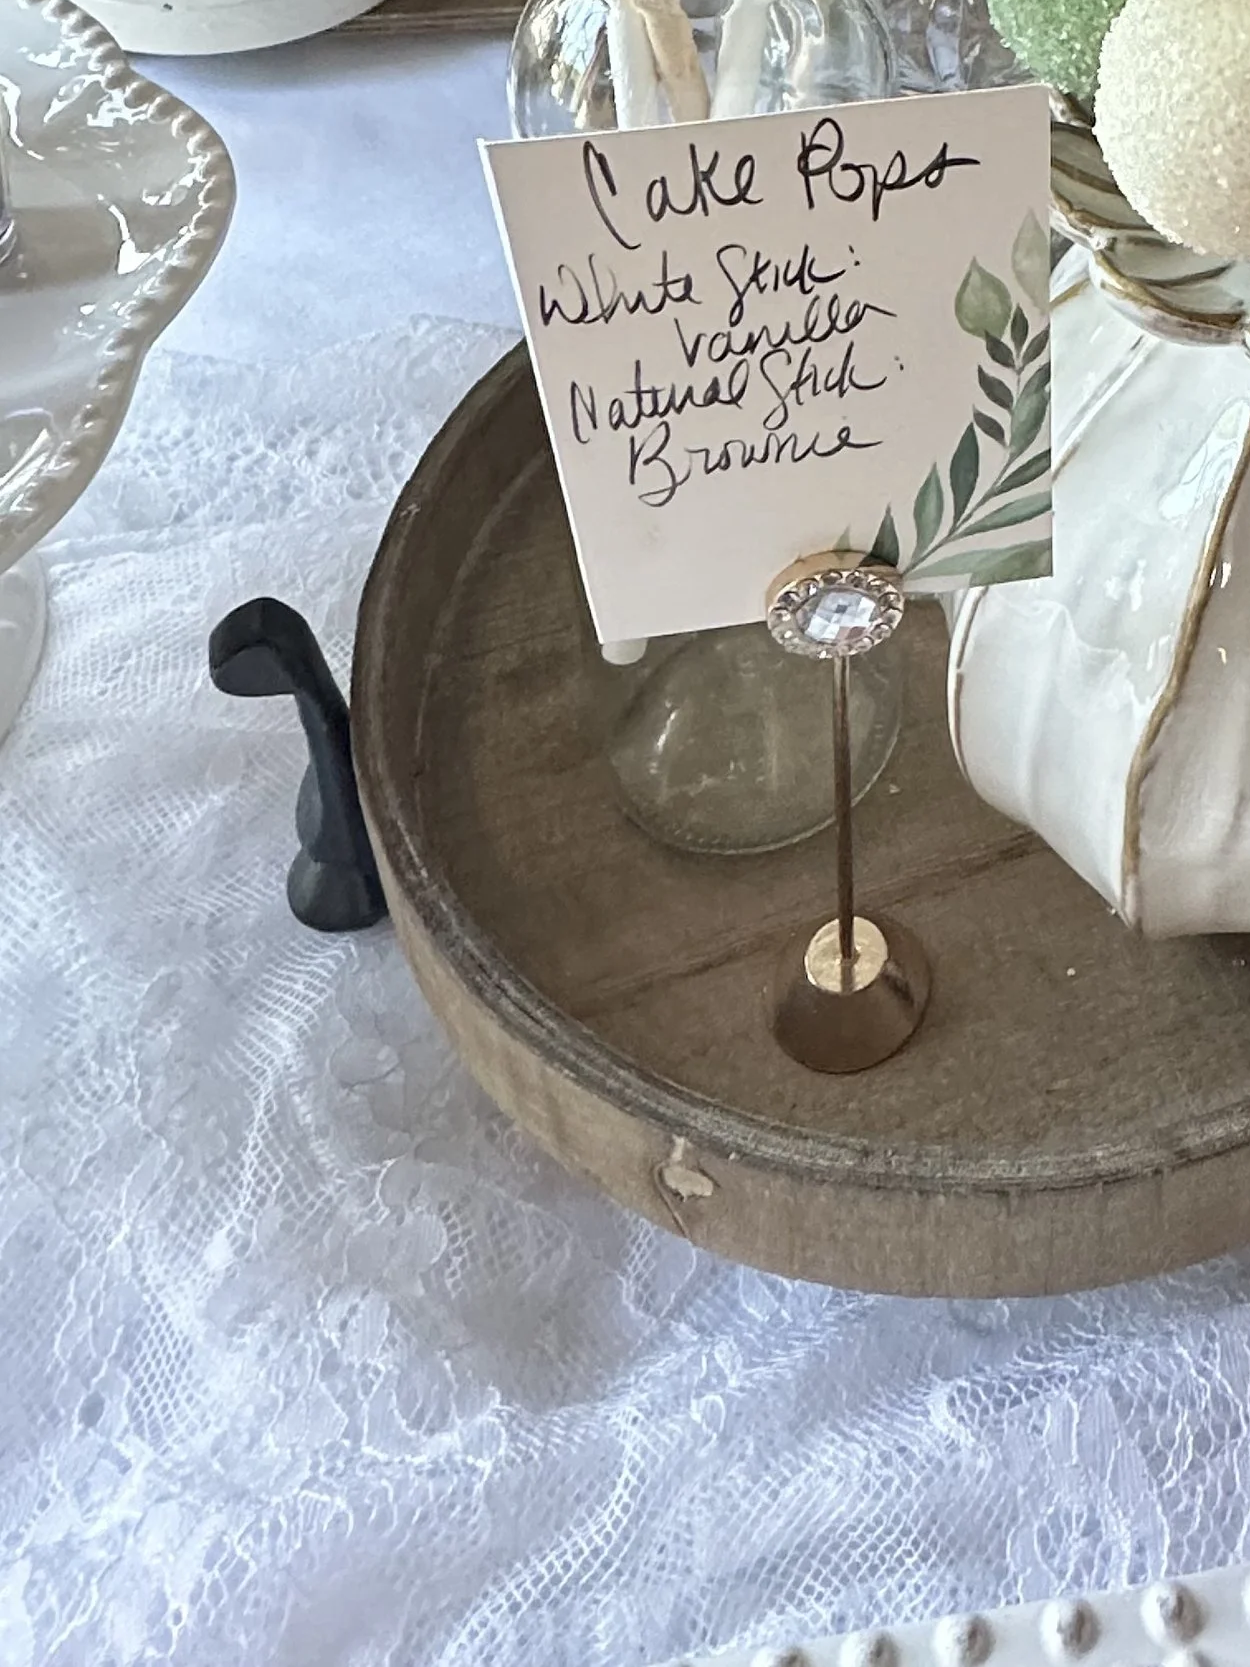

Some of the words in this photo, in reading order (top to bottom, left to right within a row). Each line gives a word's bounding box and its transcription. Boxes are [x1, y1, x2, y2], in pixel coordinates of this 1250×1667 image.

[582, 140, 764, 250] Cake
[798, 117, 982, 221] Pops
[539, 251, 701, 327] White
[674, 294, 898, 368] Vanilla
[569, 359, 750, 444] Natural
[628, 421, 882, 507] Brownie
